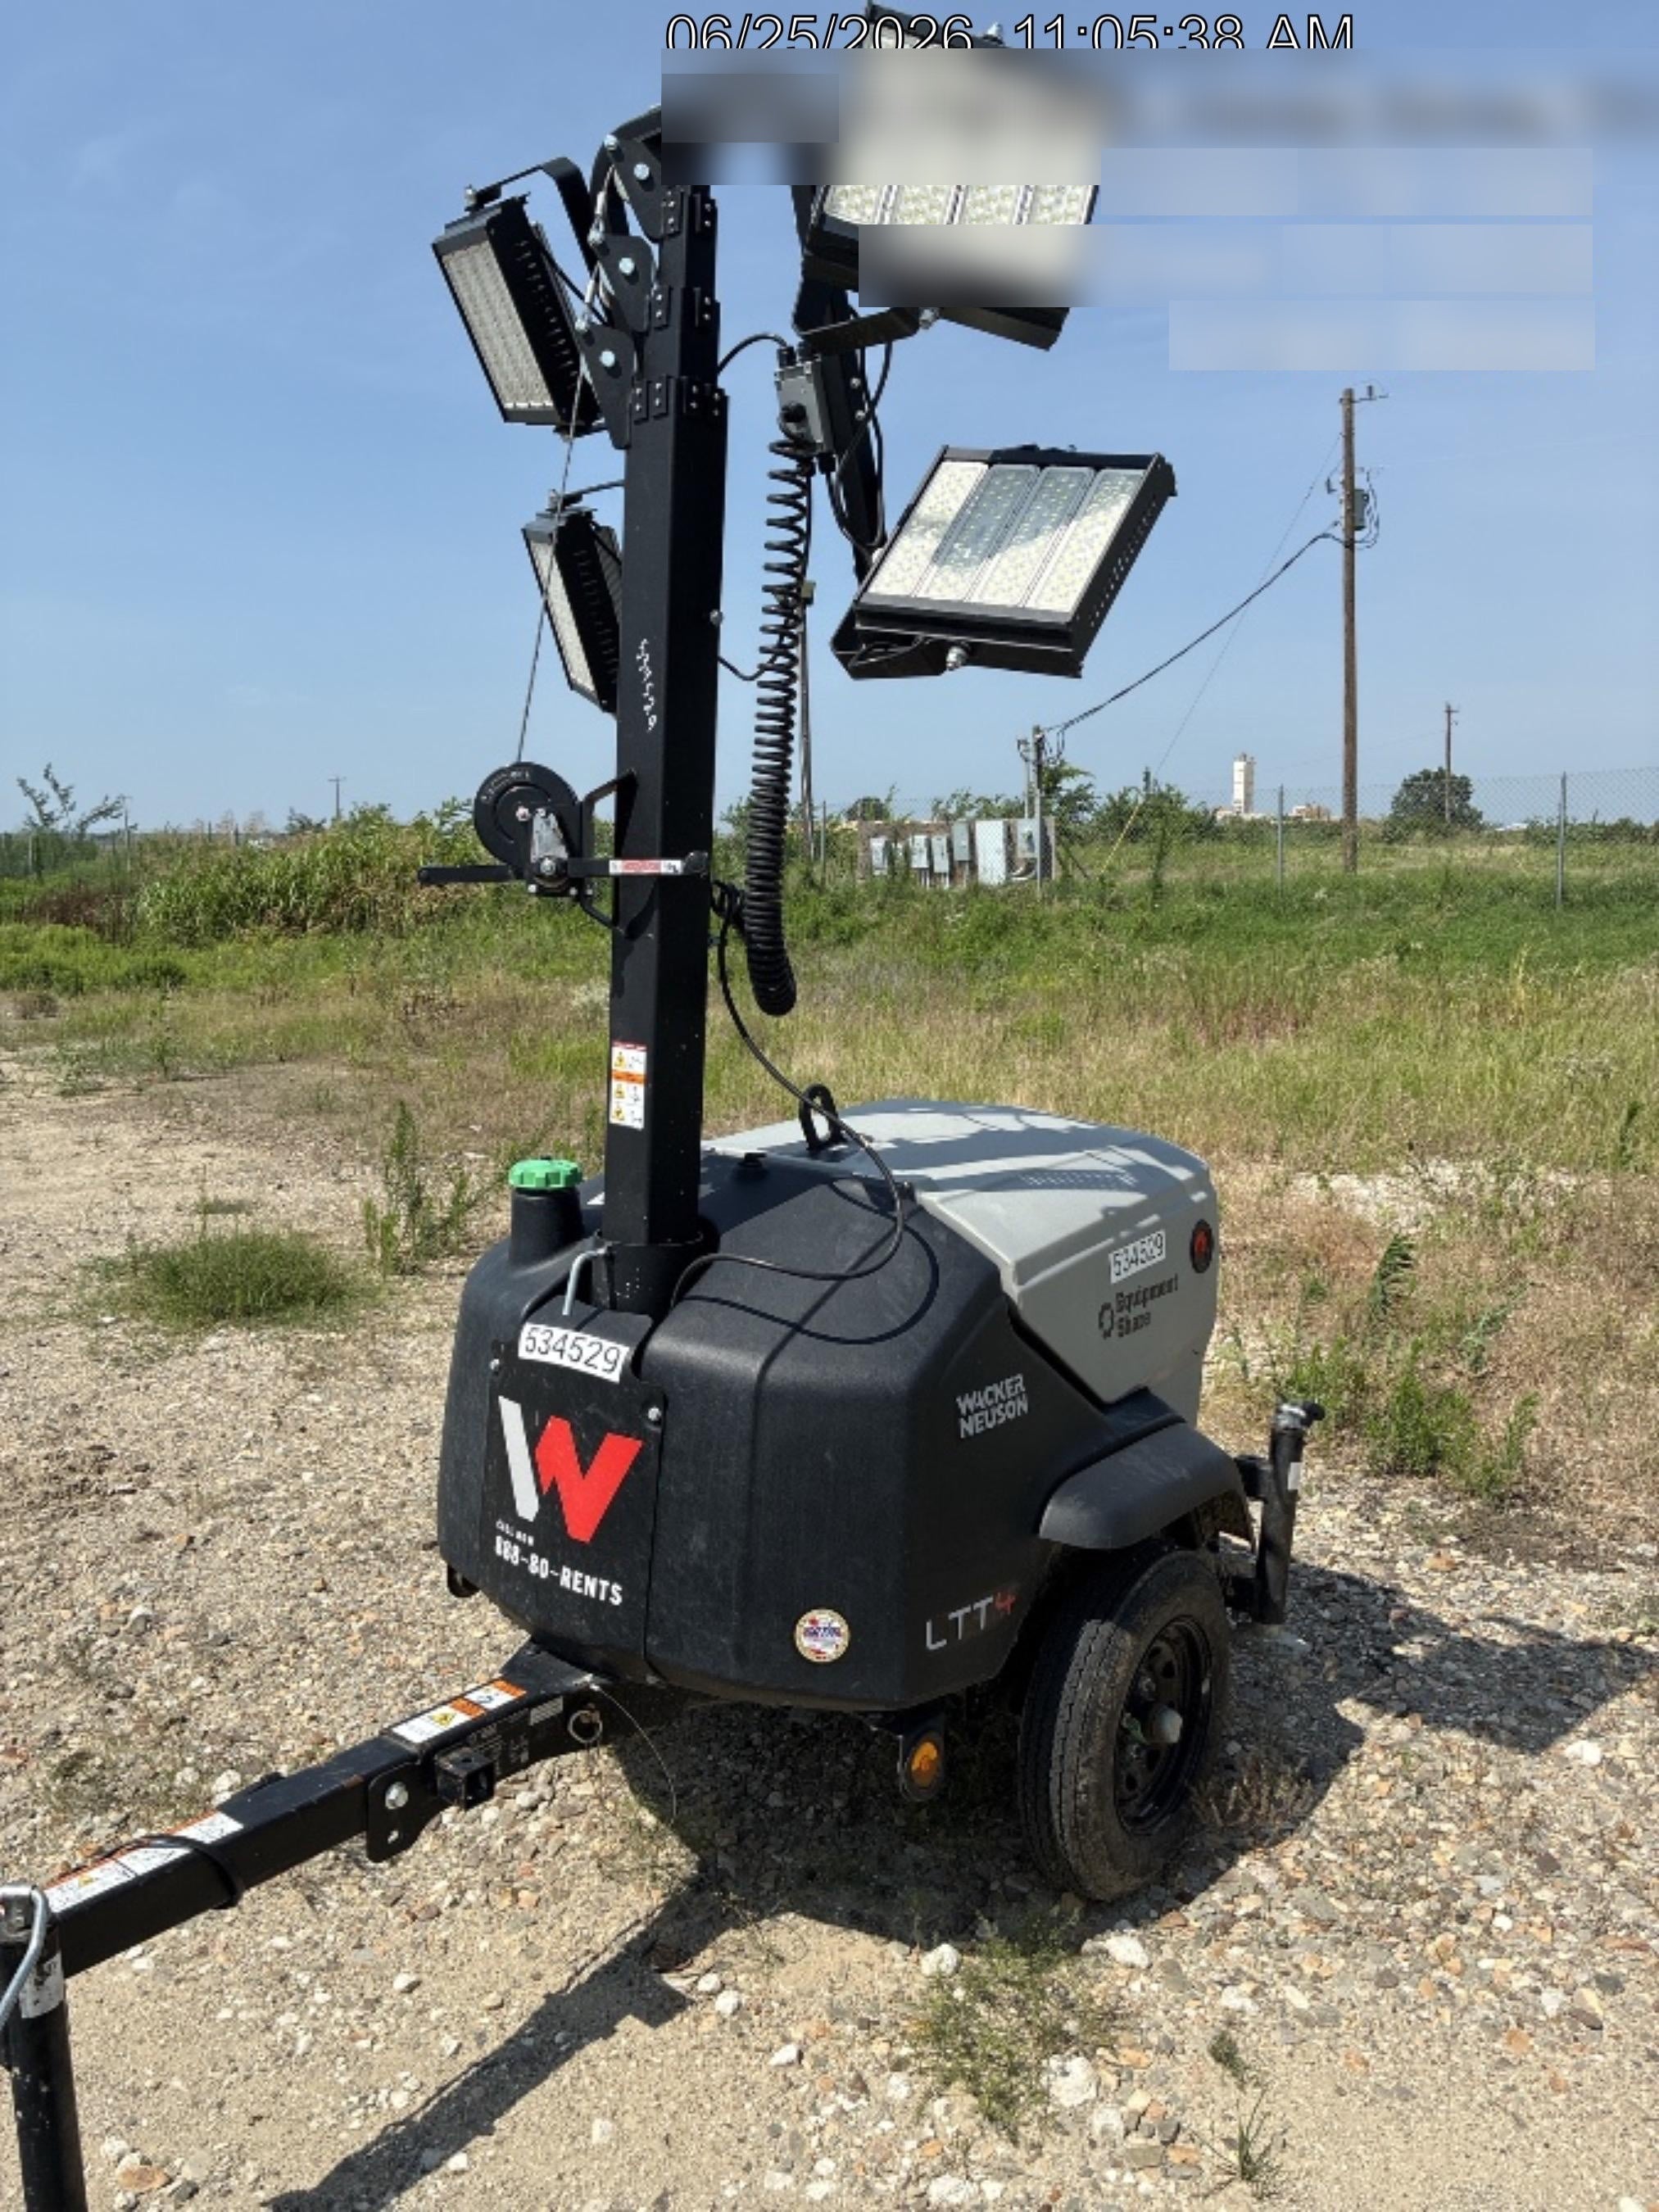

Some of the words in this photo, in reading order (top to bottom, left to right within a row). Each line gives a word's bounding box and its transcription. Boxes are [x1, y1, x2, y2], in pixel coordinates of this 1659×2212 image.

[524, 1327, 620, 1373] 534529
[955, 1373, 1027, 1416] WACKER
[959, 1392, 1029, 1439] NEUSON
